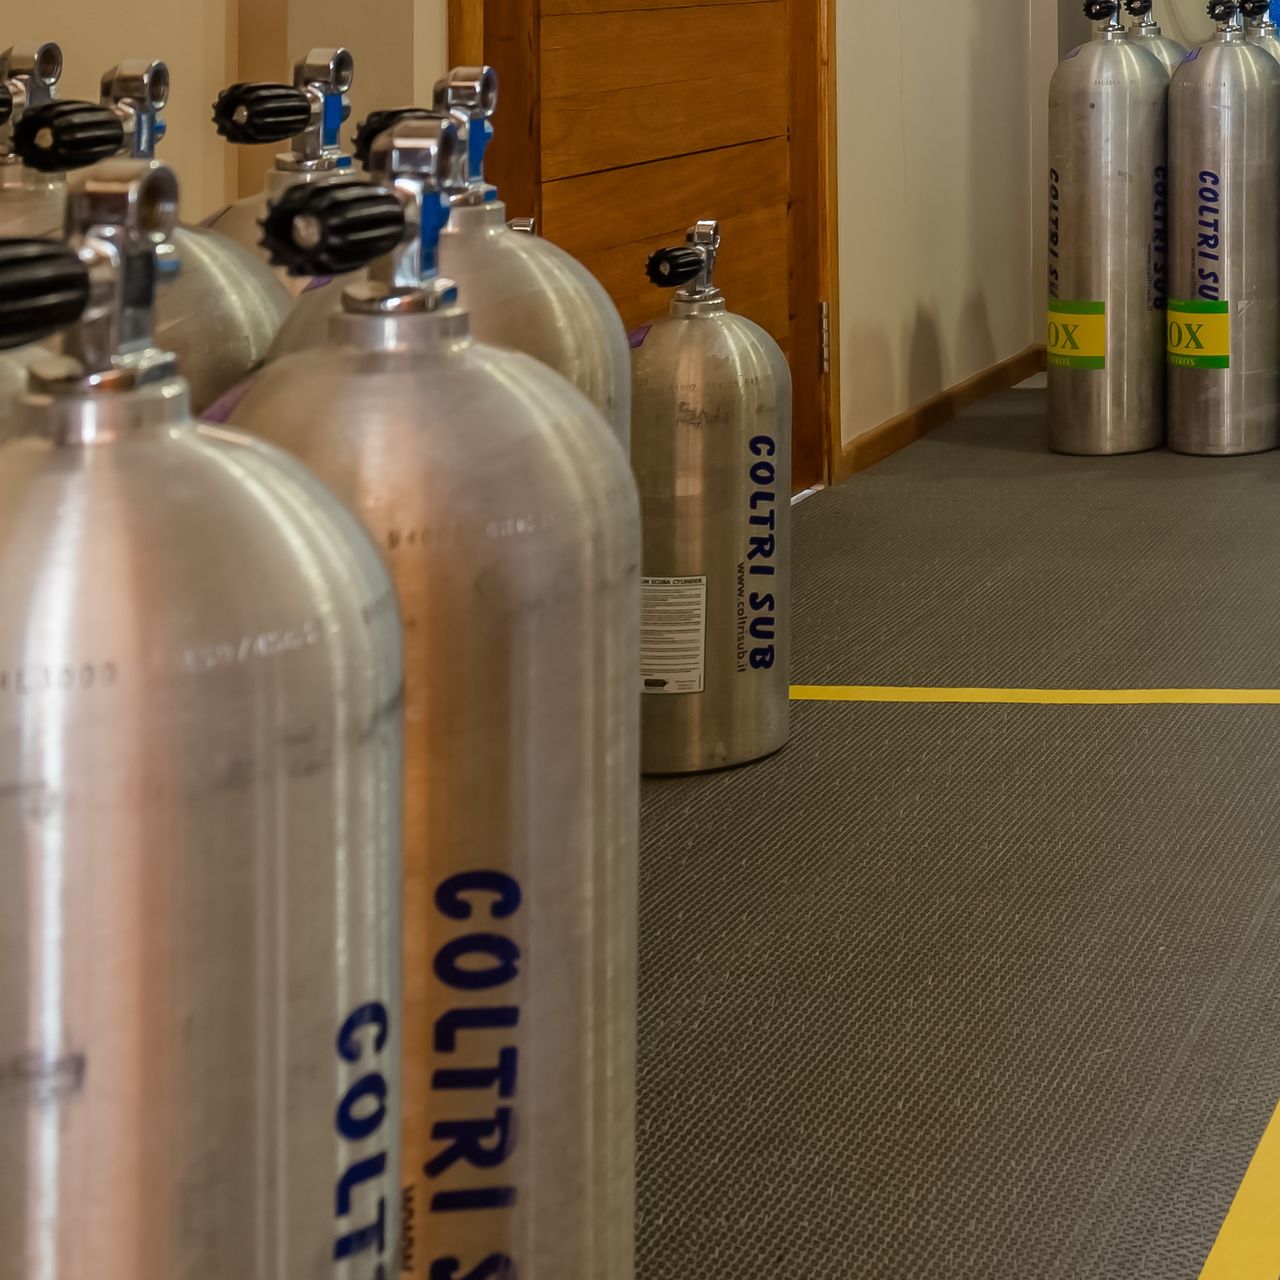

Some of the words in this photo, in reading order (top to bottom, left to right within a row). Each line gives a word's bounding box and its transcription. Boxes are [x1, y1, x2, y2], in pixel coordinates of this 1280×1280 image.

[1197, 170, 1220, 261] COLTRI
[1198, 268, 1220, 301] SU
[748, 434, 776, 577] COLTRI
[736, 562, 747, 673] www.coltrisub.it
[749, 590, 775, 671] SUB
[423, 870, 523, 1214] COLTRI
[332, 1001, 389, 1280] COLT
